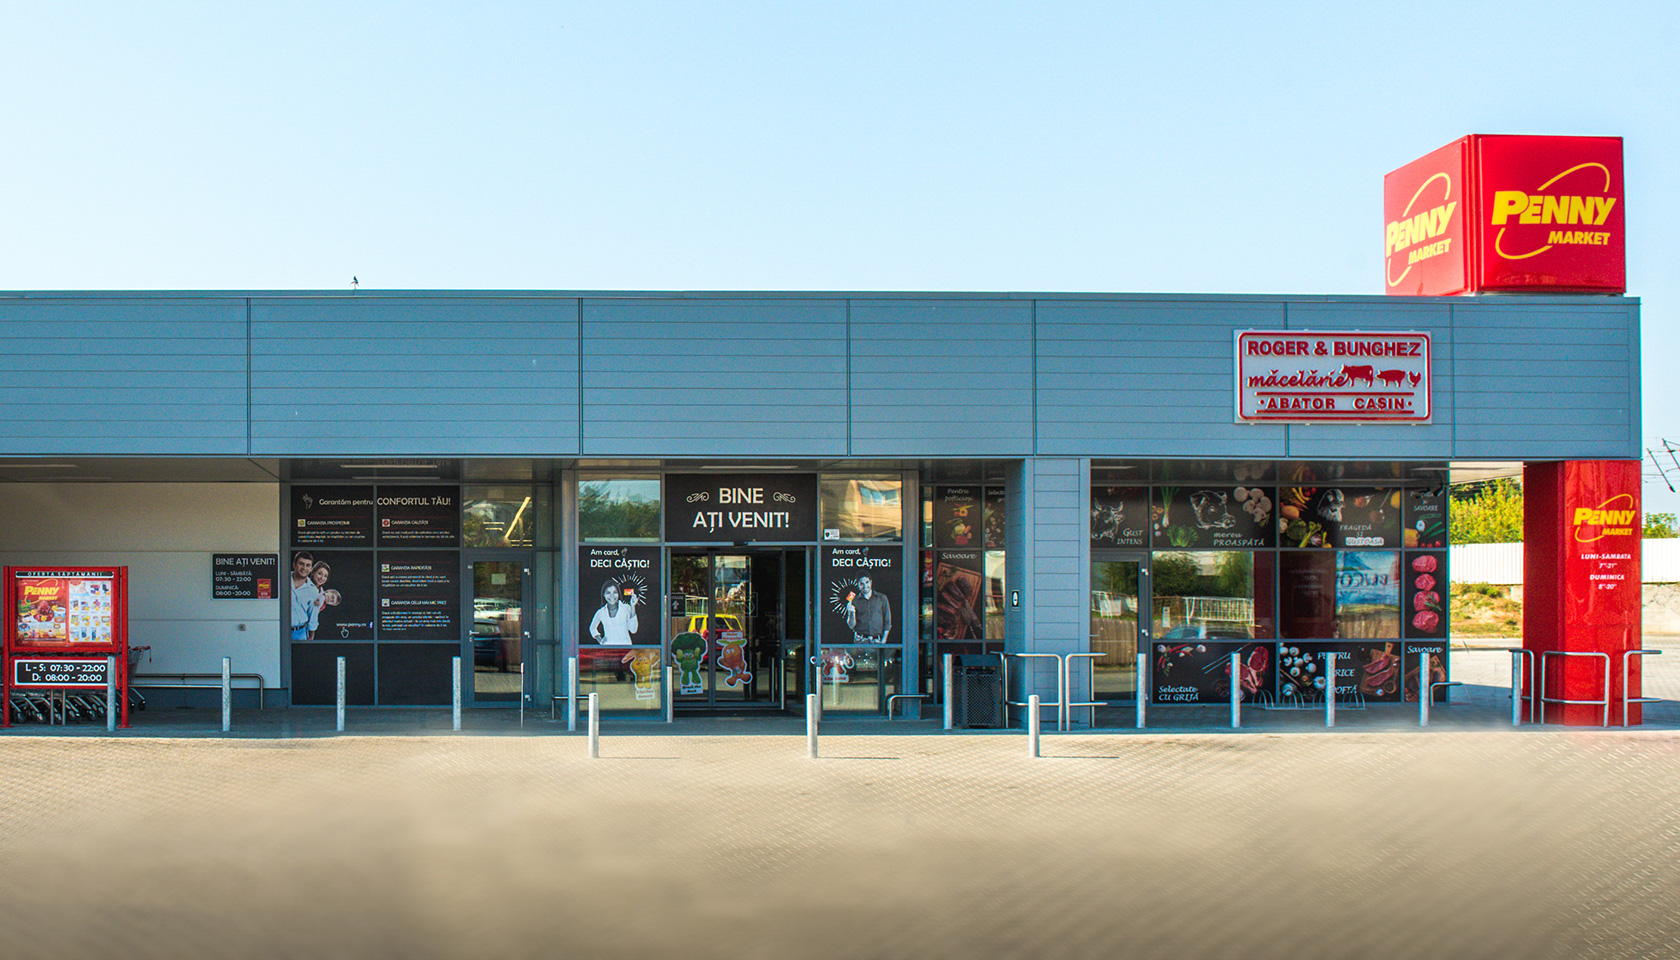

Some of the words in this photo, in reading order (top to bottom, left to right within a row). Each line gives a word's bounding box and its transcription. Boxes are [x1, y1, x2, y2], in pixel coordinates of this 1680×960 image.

[1492, 190, 1617, 226] PENNY
[1386, 201, 1457, 258] PENNY
[1548, 231, 1611, 246] MARKET
[1407, 238, 1452, 265] MARKET
[1247, 340, 1310, 356] ROGER
[1313, 341, 1329, 356] &
[1332, 341, 1422, 357] BUNGHEZ
[1248, 368, 1350, 388] măcelărie
[1265, 397, 1336, 410] ABATOR
[319, 498, 351, 506] Garantăm
[377, 497, 430, 506] CONFORTUL
[431, 495, 452, 506] TĂU!
[718, 487, 764, 504] BINE
[1573, 507, 1636, 526] PENNY
[692, 511, 723, 534] AȚI
[728, 511, 790, 528] VENIT!
[1122, 527, 1144, 537] GUST
[1602, 528, 1633, 536] MARKET
[1116, 538, 1143, 546] INTENS
[590, 548, 603, 556] Am
[832, 547, 844, 555] Am
[941, 551, 978, 560] Savoare
[215, 557, 234, 566] BINE
[235, 557, 249, 567] AȚI
[250, 557, 276, 566] VENIT!
[590, 559, 612, 568] DECI
[614, 557, 650, 571] CÂȘTIG!
[832, 558, 854, 567] DECI
[856, 556, 892, 570] CÂȘTIG!
[24, 585, 60, 595] PENNY
[1407, 645, 1443, 654] Savoare
[1317, 651, 1352, 660] PETRU
[25, 664, 31, 672] L
[39, 663, 46, 672] S:
[50, 664, 74, 672] 07:30
[82, 664, 106, 672] 22:00
[1334, 668, 1355, 677] RICE
[32, 673, 41, 681] D:
[45, 673, 70, 682] 08:00
[77, 673, 102, 682] 20:00
[1158, 684, 1199, 694] Selectate
[1158, 693, 1171, 701] CU
